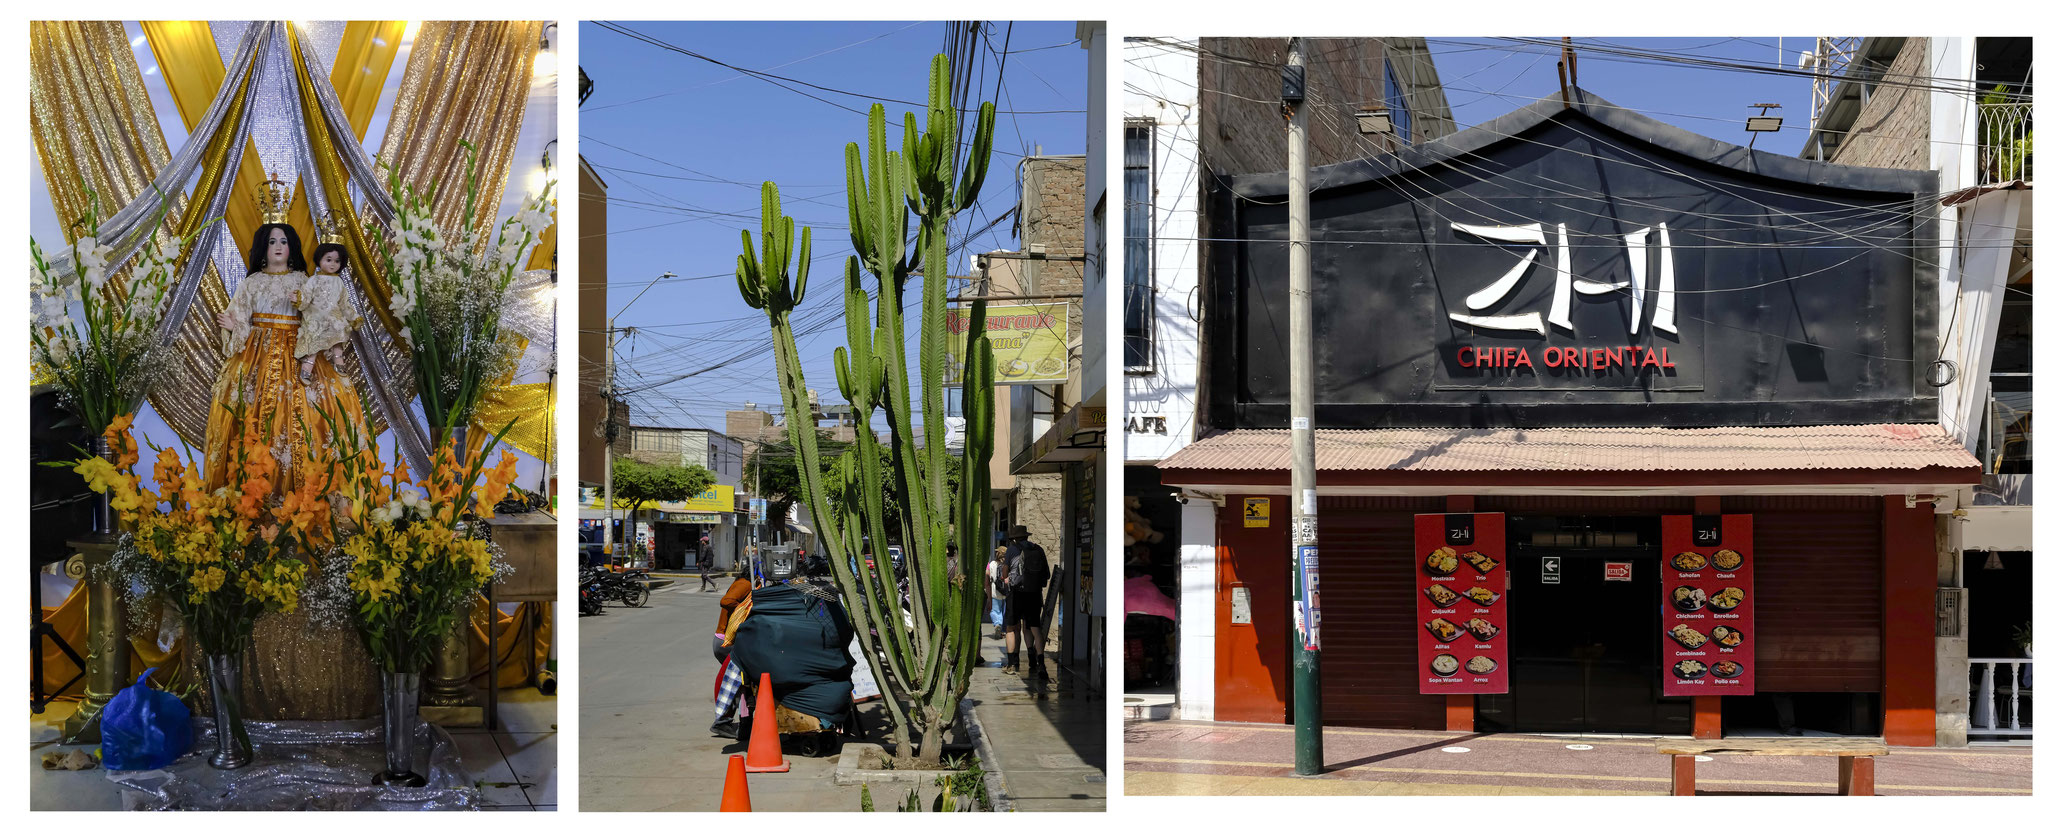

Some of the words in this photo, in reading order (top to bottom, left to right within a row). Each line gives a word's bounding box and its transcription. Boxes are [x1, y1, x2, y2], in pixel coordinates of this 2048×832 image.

[1449, 221, 1678, 336] ZHI
[946, 310, 1057, 336] Reaurante
[1457, 346, 1533, 369] CHIFA
[1543, 346, 1675, 371] ORIENTAL
